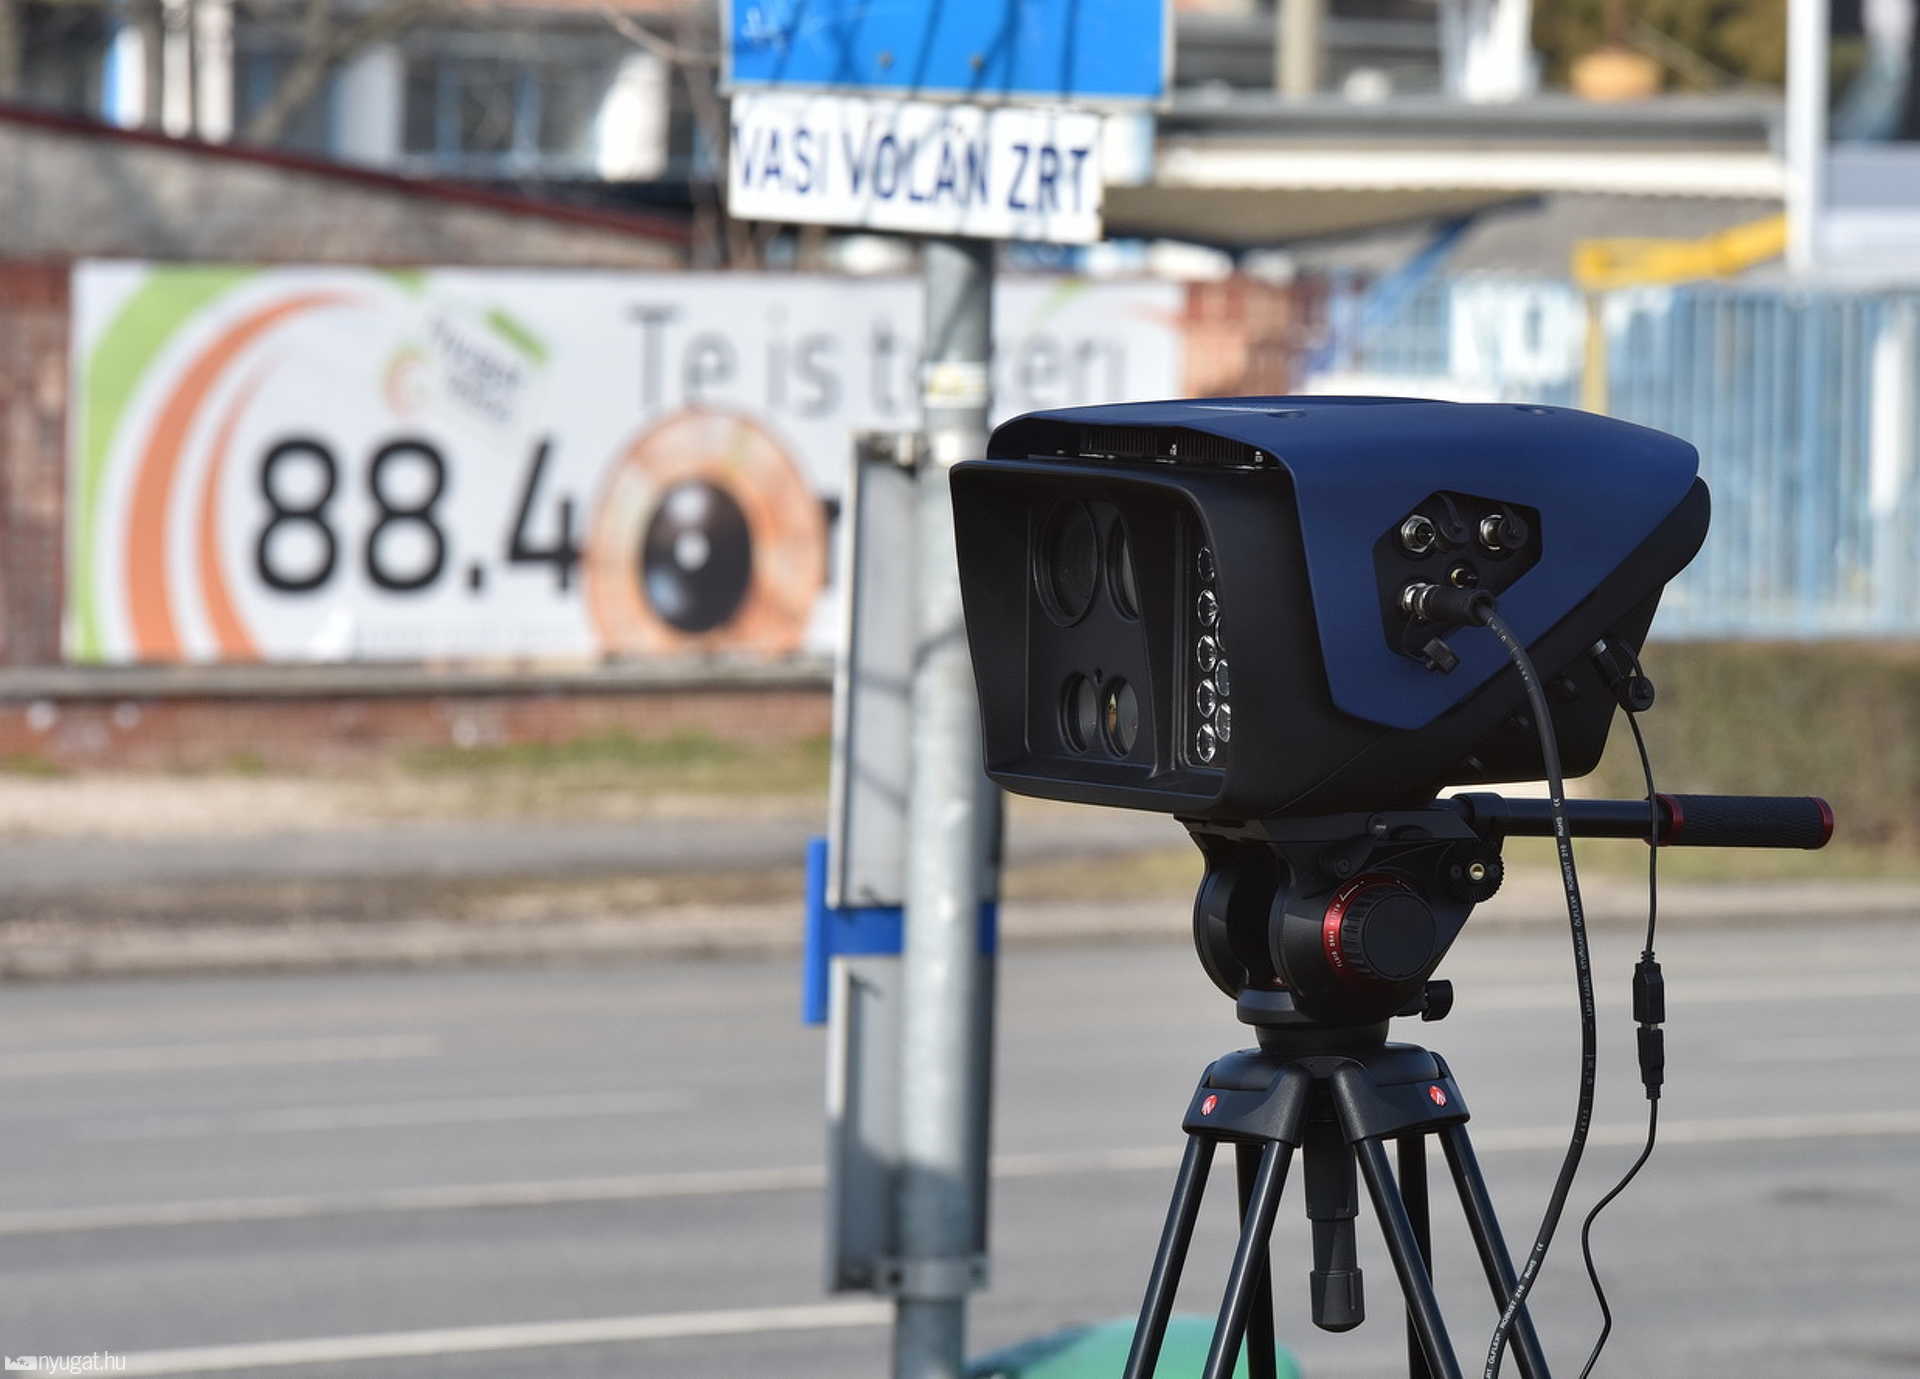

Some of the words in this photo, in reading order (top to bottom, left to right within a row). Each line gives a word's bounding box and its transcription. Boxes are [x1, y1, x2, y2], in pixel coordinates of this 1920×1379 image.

[730, 123, 831, 194] VASI
[842, 119, 989, 206] VOLÁN
[1007, 142, 1091, 214] ZRT
[629, 303, 741, 414] Te
[765, 303, 843, 420] is
[254, 437, 583, 596] 88.4
